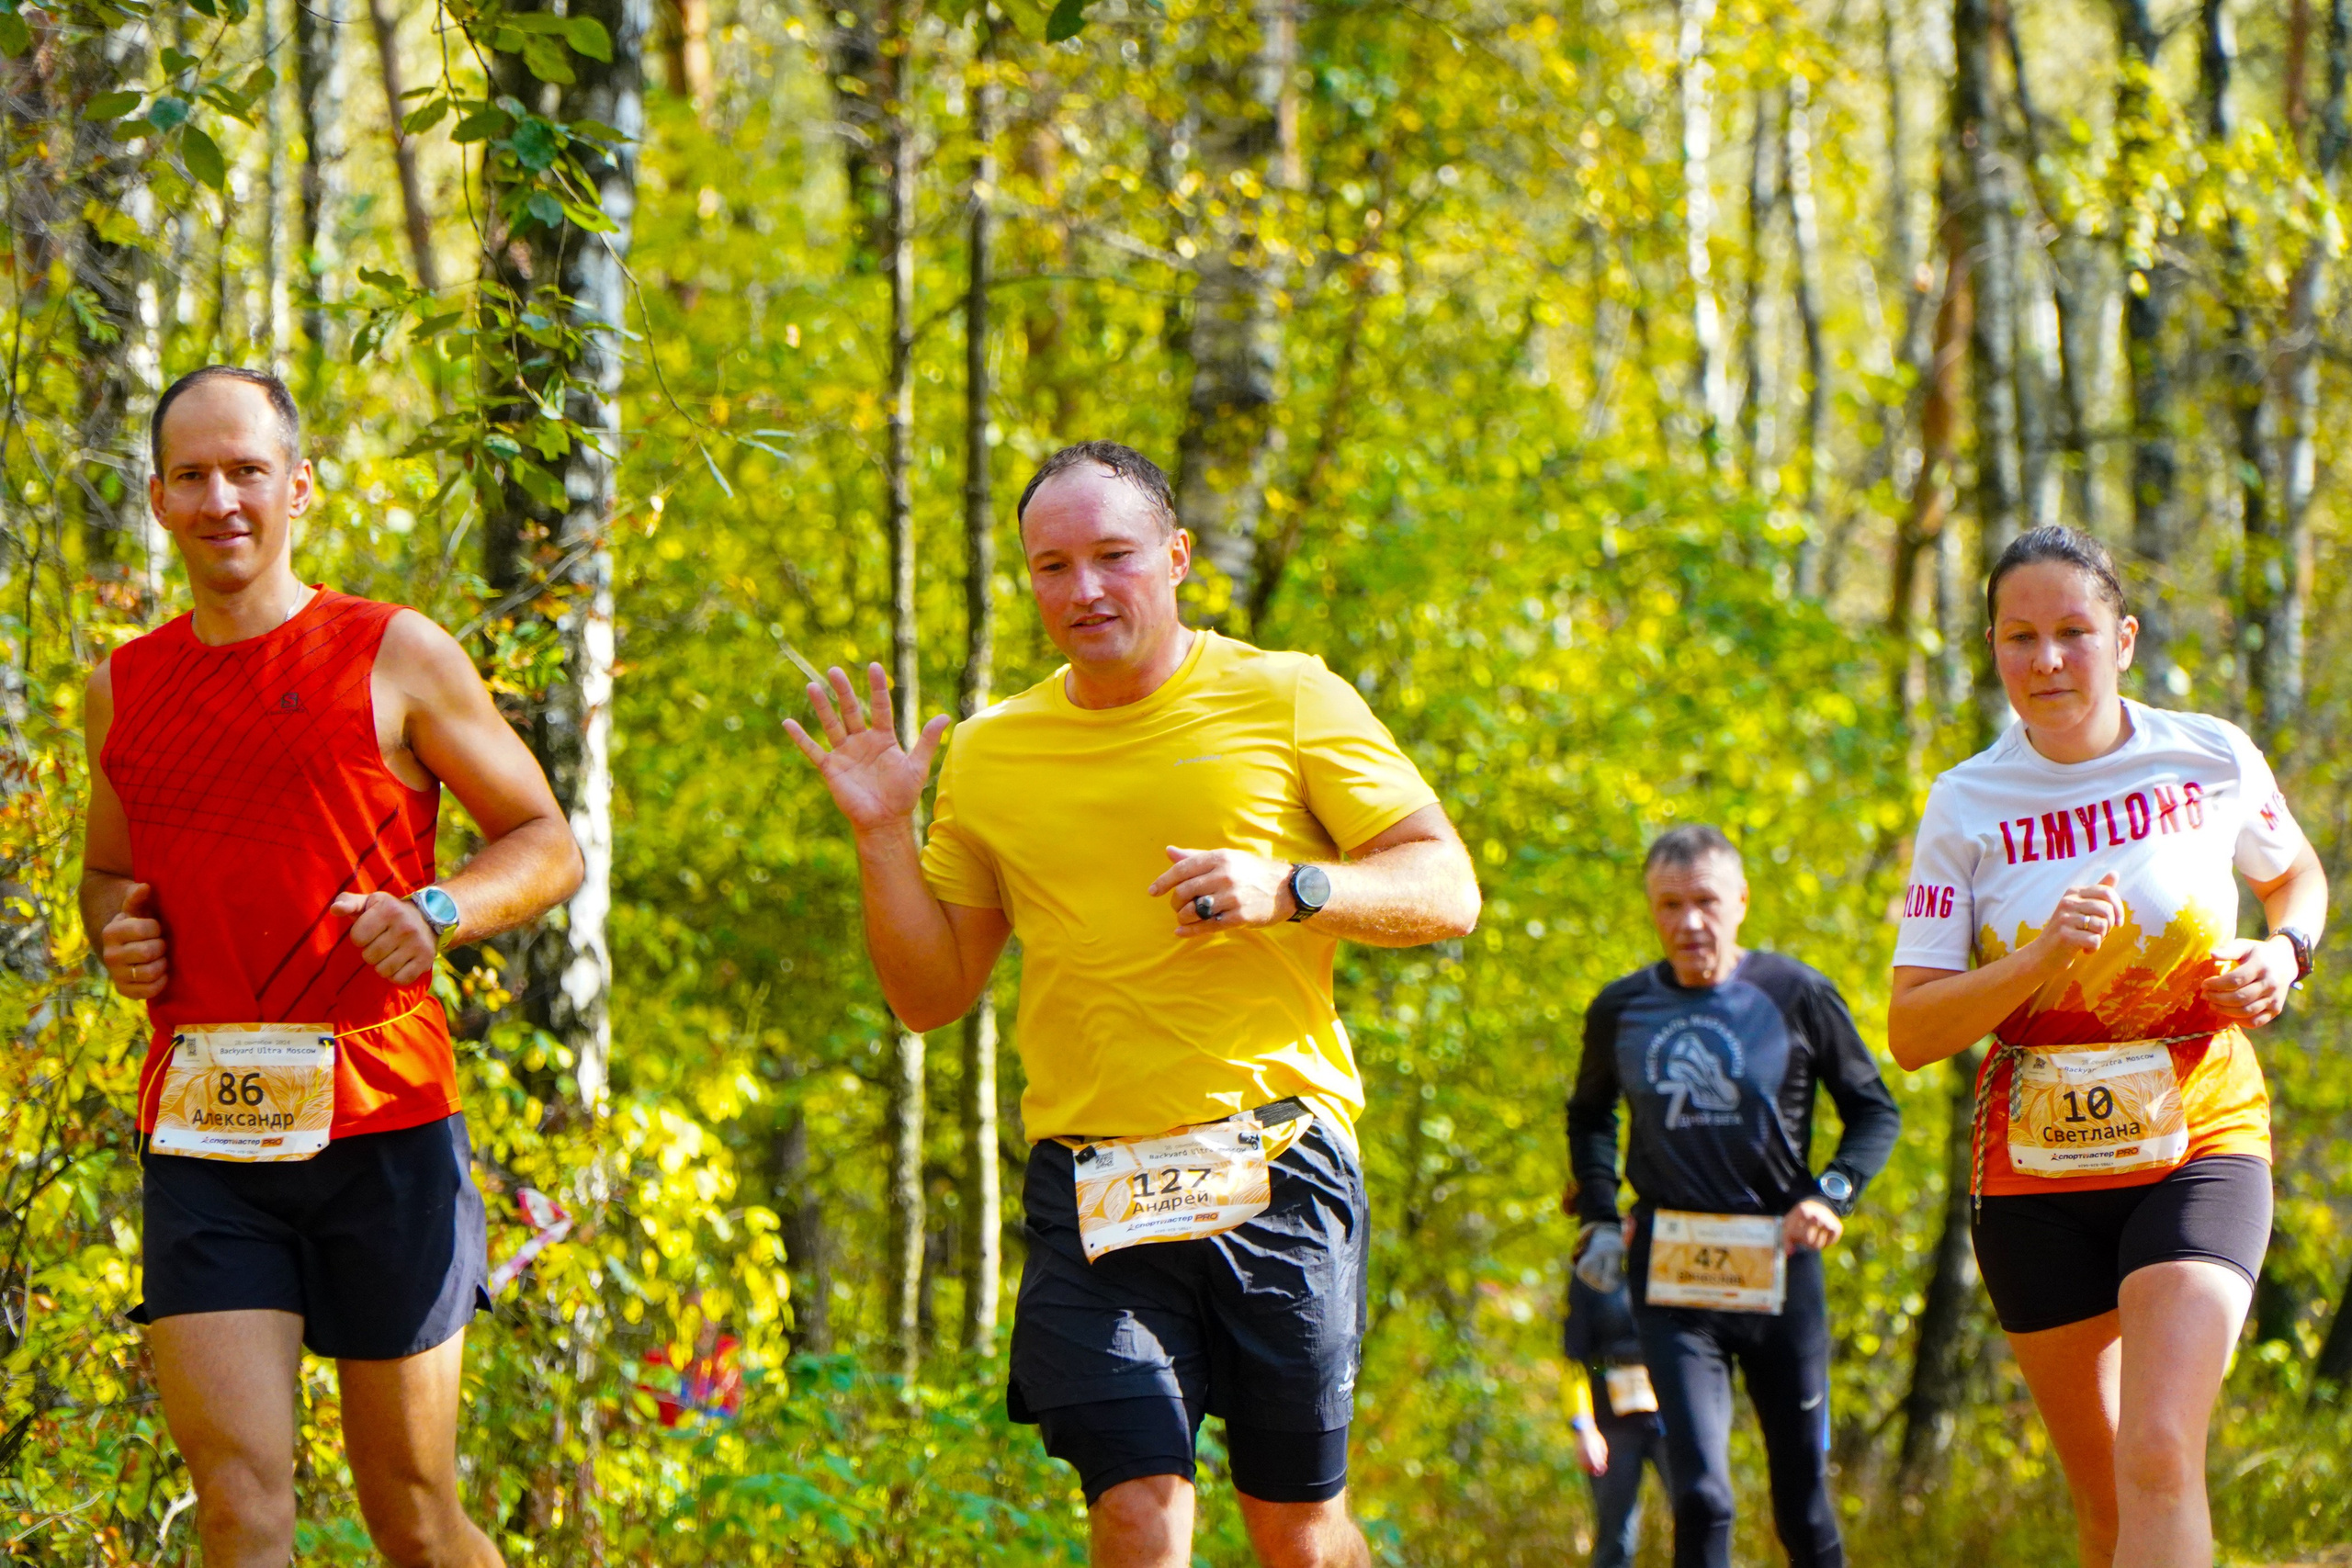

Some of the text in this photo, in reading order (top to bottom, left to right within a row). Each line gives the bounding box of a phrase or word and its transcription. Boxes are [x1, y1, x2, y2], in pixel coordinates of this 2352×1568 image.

[1998, 782, 2205, 865] IZMYLONG
[220, 1047, 254, 1055] Backyard
[2126, 1054, 2154, 1062] Moscow
[217, 1071, 265, 1107] 86
[2062, 1085, 2114, 1122] 10
[192, 1109, 294, 1130] Александр
[209, 1137, 283, 1146] спортмастер PRO
[2042, 1121, 2142, 1143] Светлана
[1148, 1149, 1188, 1160] Backyard
[2058, 1146, 2140, 1160] спортмастер PRO
[1132, 1168, 1212, 1198] 127
[1132, 1190, 1210, 1215] Андрей
[1135, 1212, 1219, 1229] спортмастер PRO
[1693, 1246, 1730, 1270] 47
